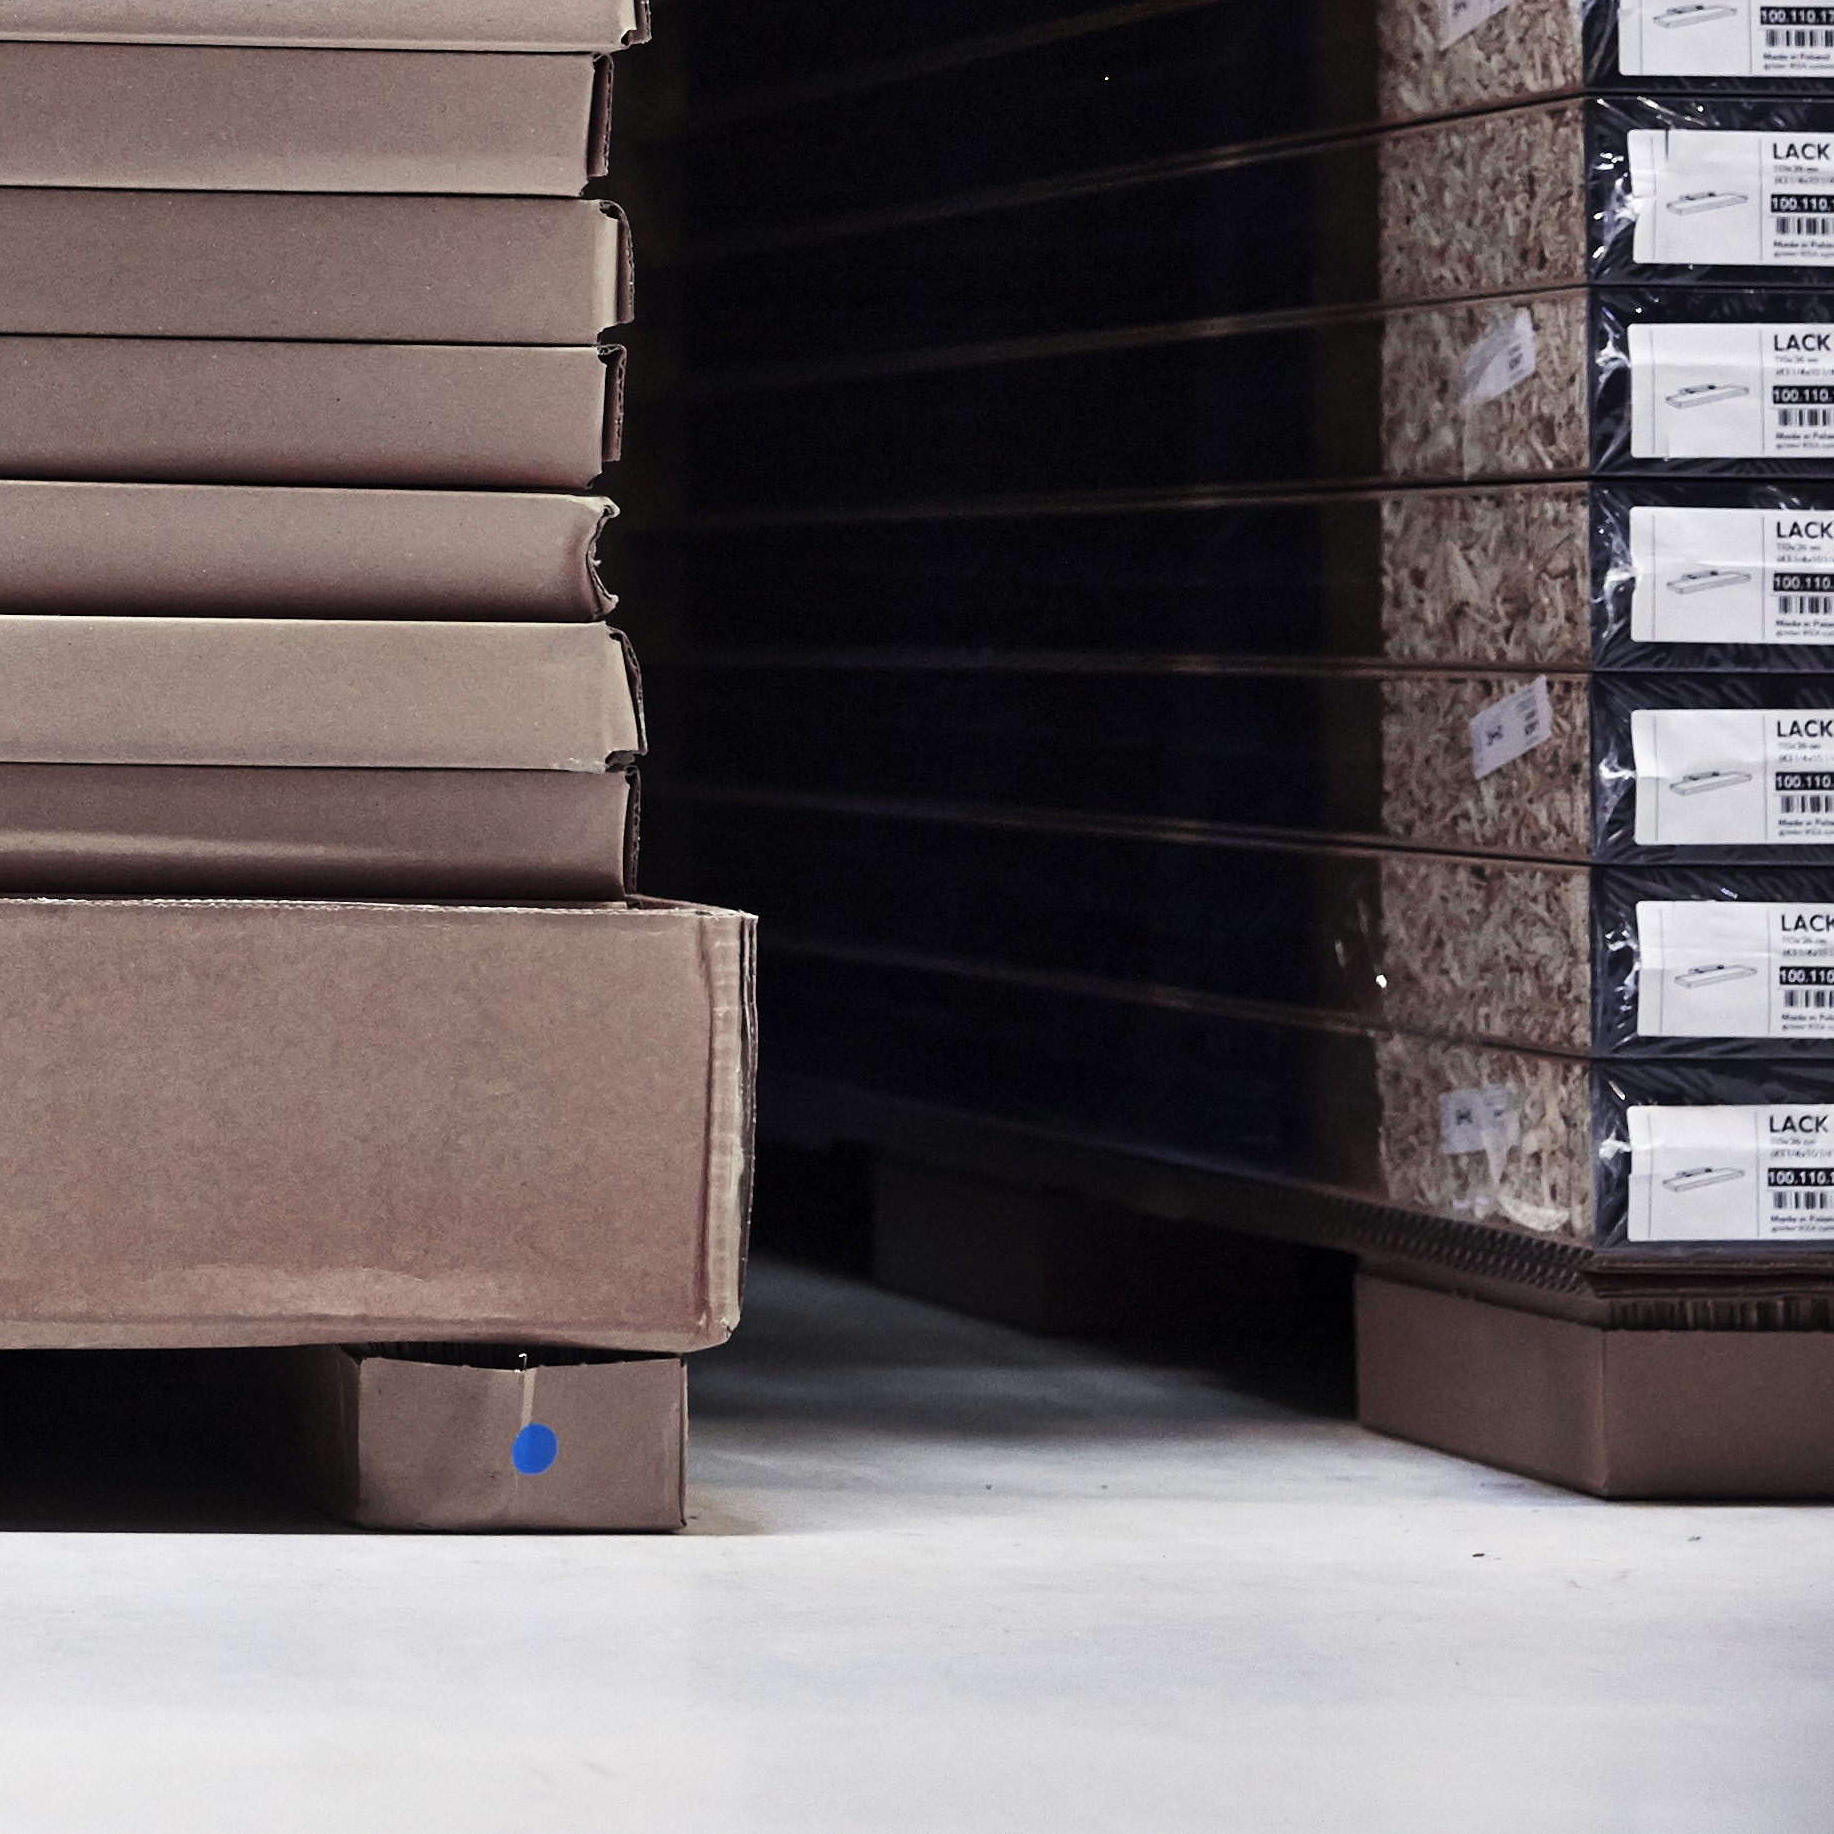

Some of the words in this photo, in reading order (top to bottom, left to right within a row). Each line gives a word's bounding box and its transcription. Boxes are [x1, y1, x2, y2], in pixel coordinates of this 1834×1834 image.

[1773, 143, 1830, 160] LACK
[1773, 333, 1831, 352] LACK
[1776, 521, 1833, 539] LACK
[1777, 719, 1833, 738] LACK
[1769, 1115, 1828, 1134] LACK
